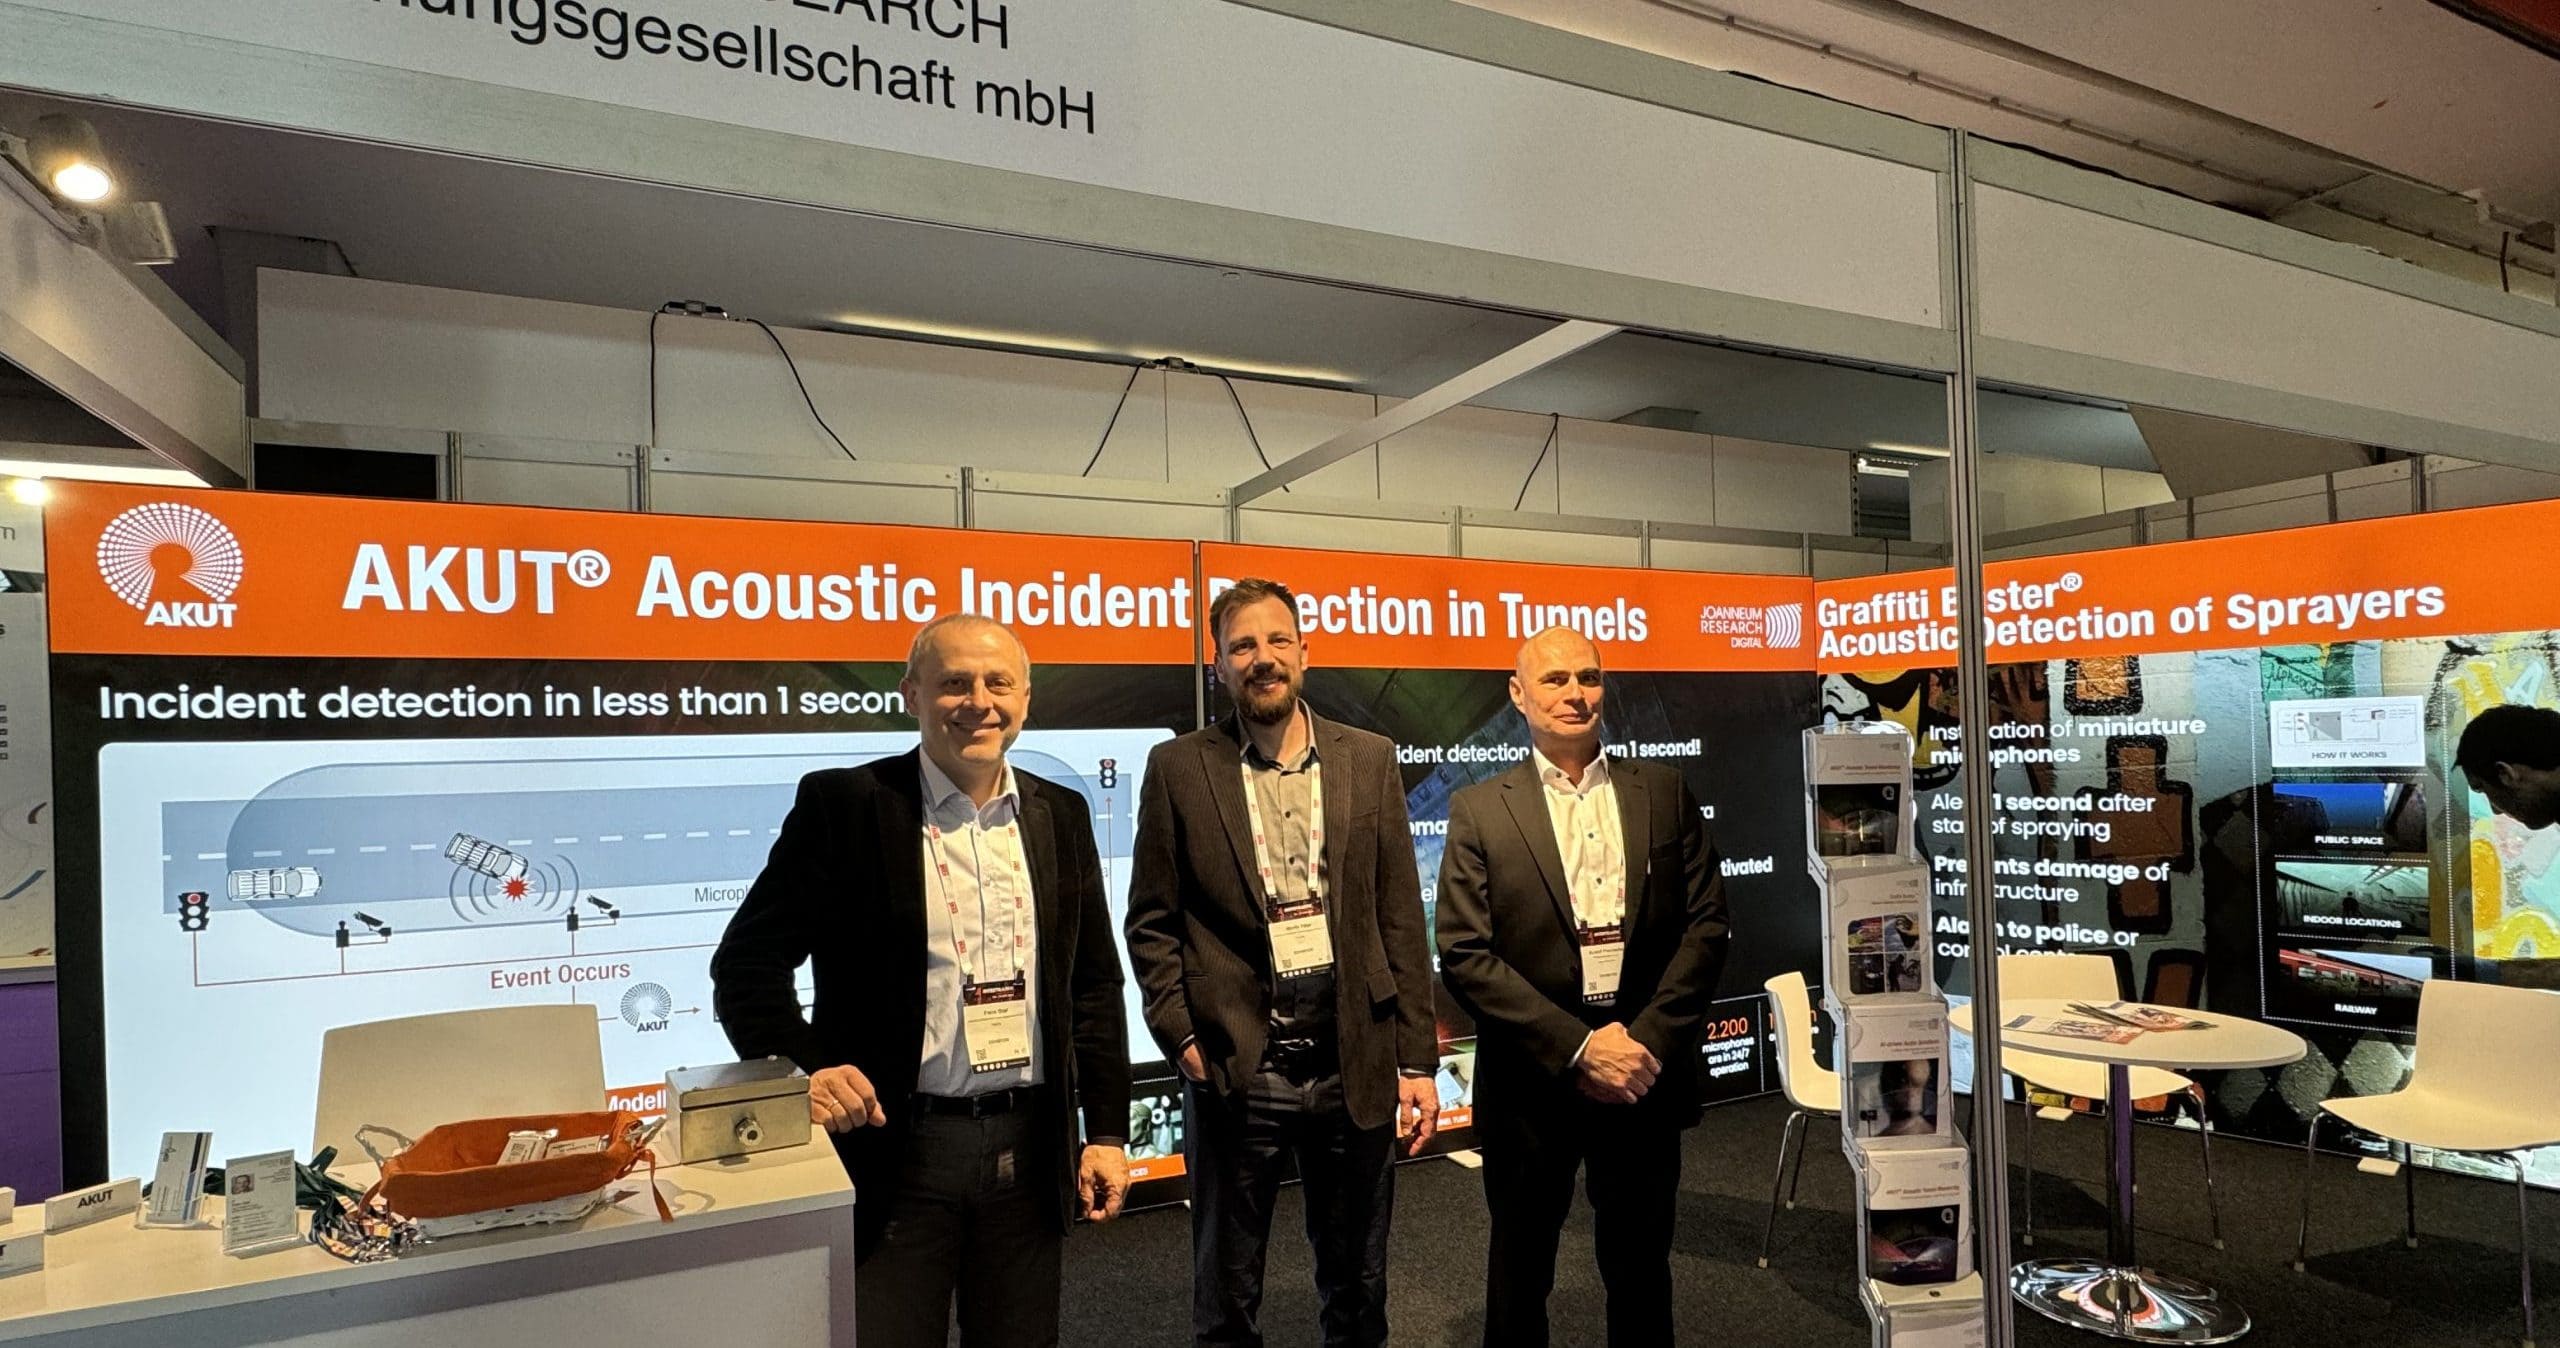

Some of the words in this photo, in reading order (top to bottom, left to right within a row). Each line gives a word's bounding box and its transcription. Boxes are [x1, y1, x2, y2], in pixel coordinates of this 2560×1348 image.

[977, 79, 1096, 134] mbH
[636, 554, 937, 623] Acoustic
[961, 567, 1192, 628] Incident
[1449, 589, 1486, 637] in
[1498, 592, 1648, 642] Tunnels
[1817, 588, 1930, 627] Graffiti
[144, 602, 238, 628] AKUT
[1700, 605, 1762, 620] JOANNEUM
[1818, 621, 1959, 659] Acoustic
[2169, 597, 2213, 633] of
[2226, 585, 2446, 636] Sprayers
[1700, 620, 1763, 634] RESEARCH
[1731, 637, 1763, 649] DIGITAL
[100, 685, 306, 720] Incident
[318, 684, 532, 719] detection
[544, 684, 580, 717] in
[593, 685, 669, 717] less
[679, 685, 767, 716] than
[777, 686, 788, 714] 1
[799, 691, 905, 714] secon
[2050, 721, 2074, 737] of
[2078, 717, 2207, 737] miniature
[1395, 744, 1444, 764] ident
[1447, 742, 1530, 763] detection
[1629, 740, 1637, 758] 1
[1639, 738, 1702, 758] second!
[2311, 751, 2337, 760] HOW
[2338, 751, 2348, 760] IT
[2350, 751, 2387, 760] WORKS
[1931, 792, 1964, 810] Ale
[1992, 793, 2002, 810] 1
[2006, 793, 2092, 811] second
[2097, 793, 2156, 812] after
[1932, 817, 1965, 834] sta
[2010, 818, 2111, 843] spraying
[2314, 835, 2349, 844] PUBLIC
[2351, 836, 2385, 845] SPACE
[1719, 855, 1774, 877] tivated
[1934, 855, 2031, 876] Prents
[2034, 858, 2140, 886] damage
[2145, 862, 2170, 881] of
[694, 885, 749, 903] Microp
[2303, 915, 2343, 925] INDOOR
[2345, 917, 2402, 928] LOCATIONS
[2007, 920, 2032, 939] to
[2035, 923, 2109, 945] police
[2113, 931, 2140, 947] or
[491, 965, 551, 989] Event
[558, 962, 631, 984] Occurs
[2334, 1003, 2378, 1015] RAILWAY
[637, 1019, 670, 1033] AKUT
[1707, 1017, 1748, 1040] 2.200
[1702, 1036, 1755, 1054] microphones
[1723, 1052, 1732, 1062] in
[1731, 1047, 1750, 1061] 24/7
[1709, 1061, 1750, 1078] operation
[77, 1189, 114, 1209] AKUT
